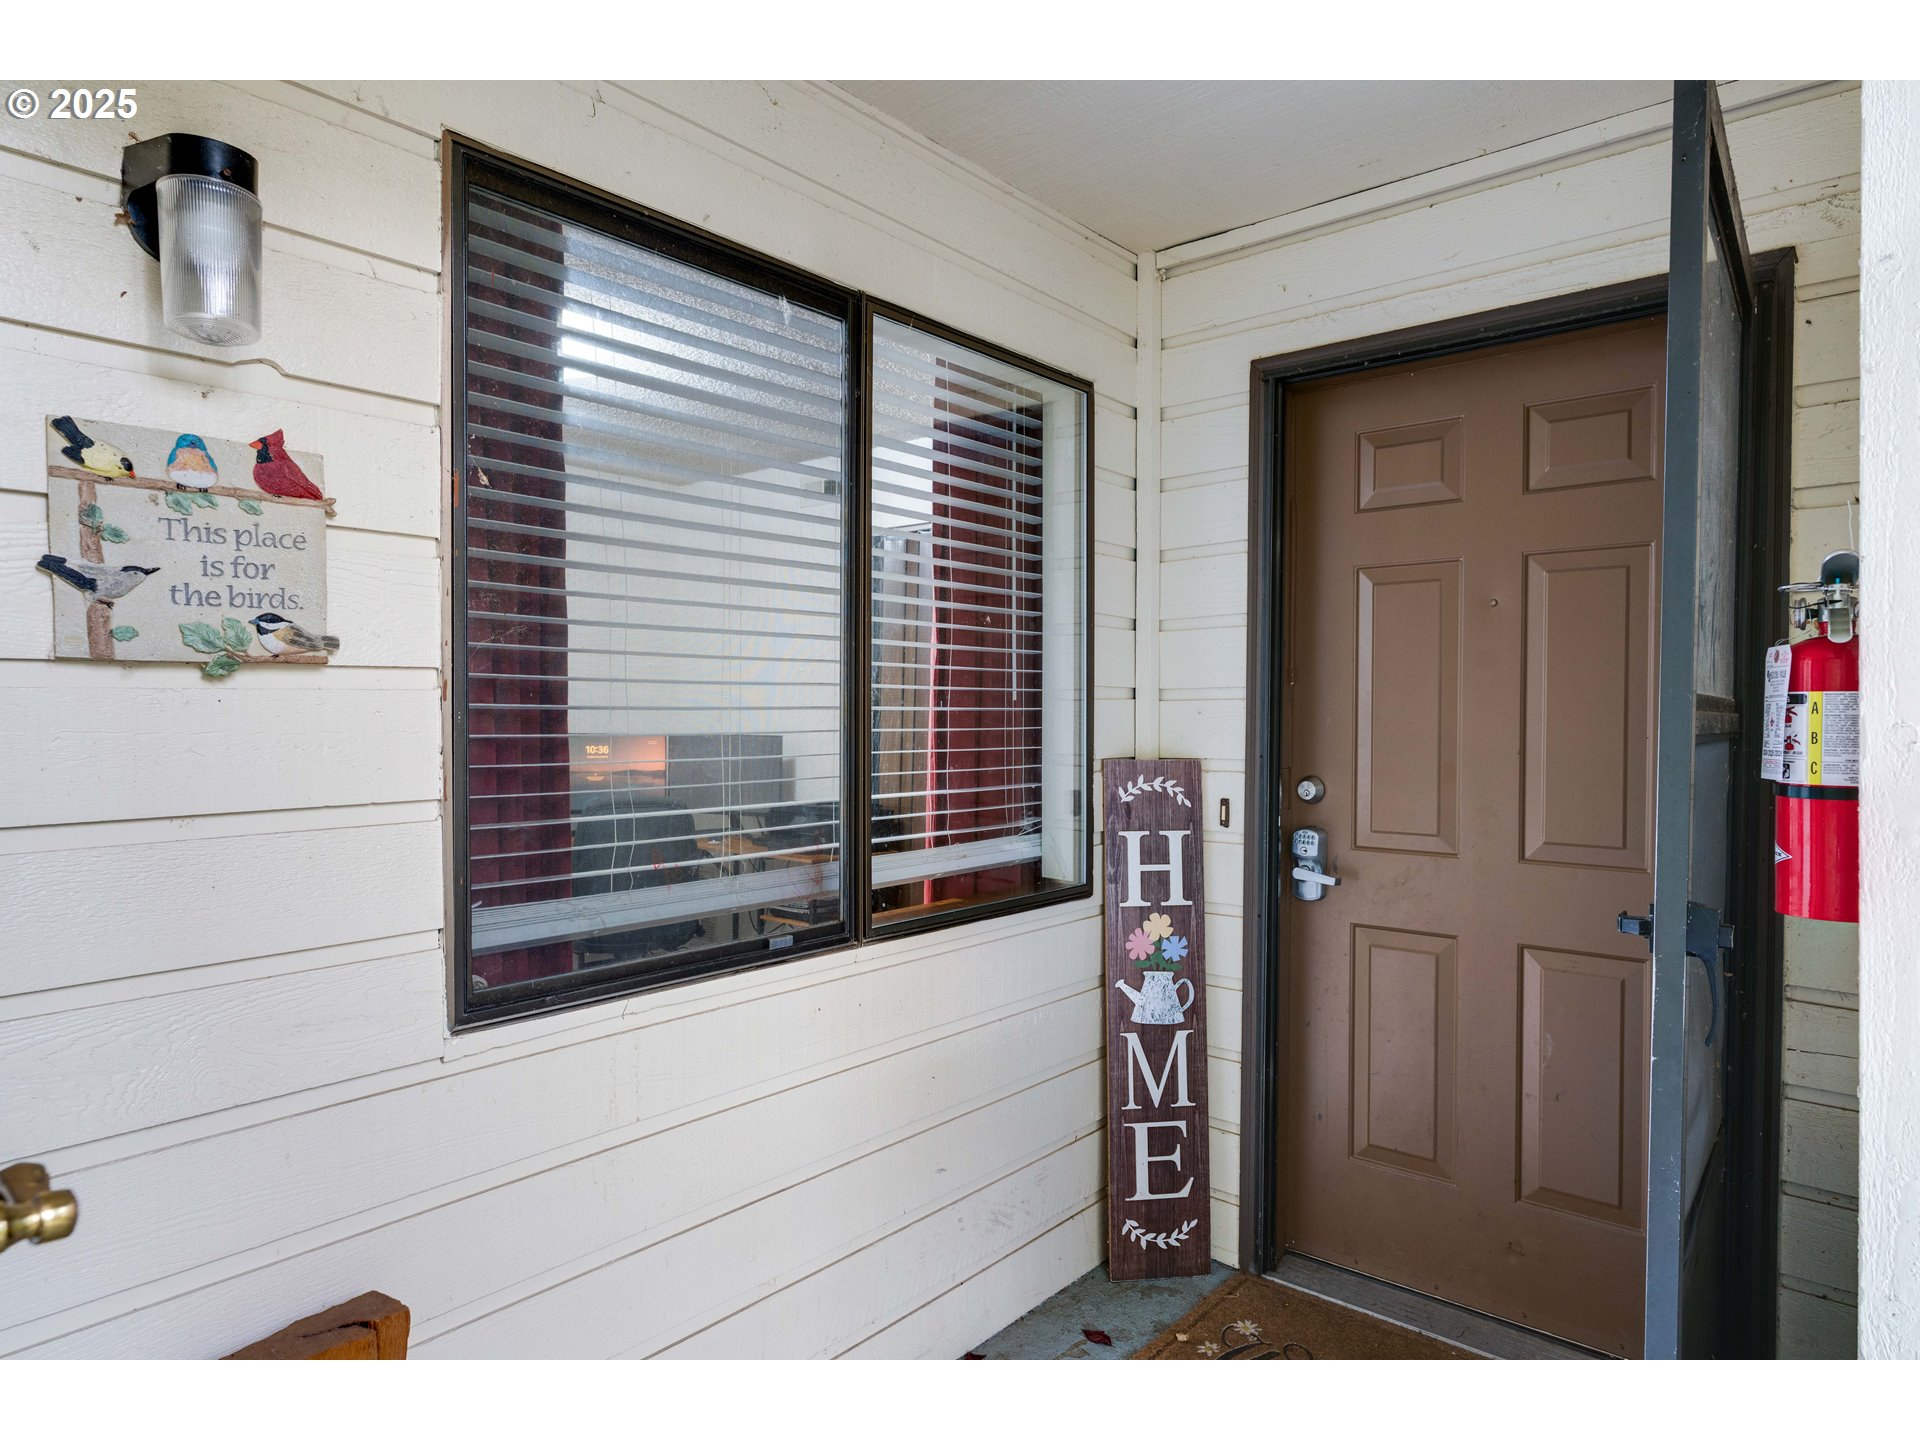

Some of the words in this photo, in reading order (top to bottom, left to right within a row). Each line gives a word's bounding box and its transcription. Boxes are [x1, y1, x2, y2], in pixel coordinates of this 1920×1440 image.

[158, 517, 227, 545] This
[233, 522, 307, 551] place
[200, 554, 225, 578] is
[230, 555, 275, 581] for
[169, 582, 221, 608] the
[226, 584, 304, 611] birds.
[1811, 702, 1819, 715] A
[1811, 731, 1819, 745] B
[585, 745, 609, 754] 10:36
[1810, 761, 1818, 775] C
